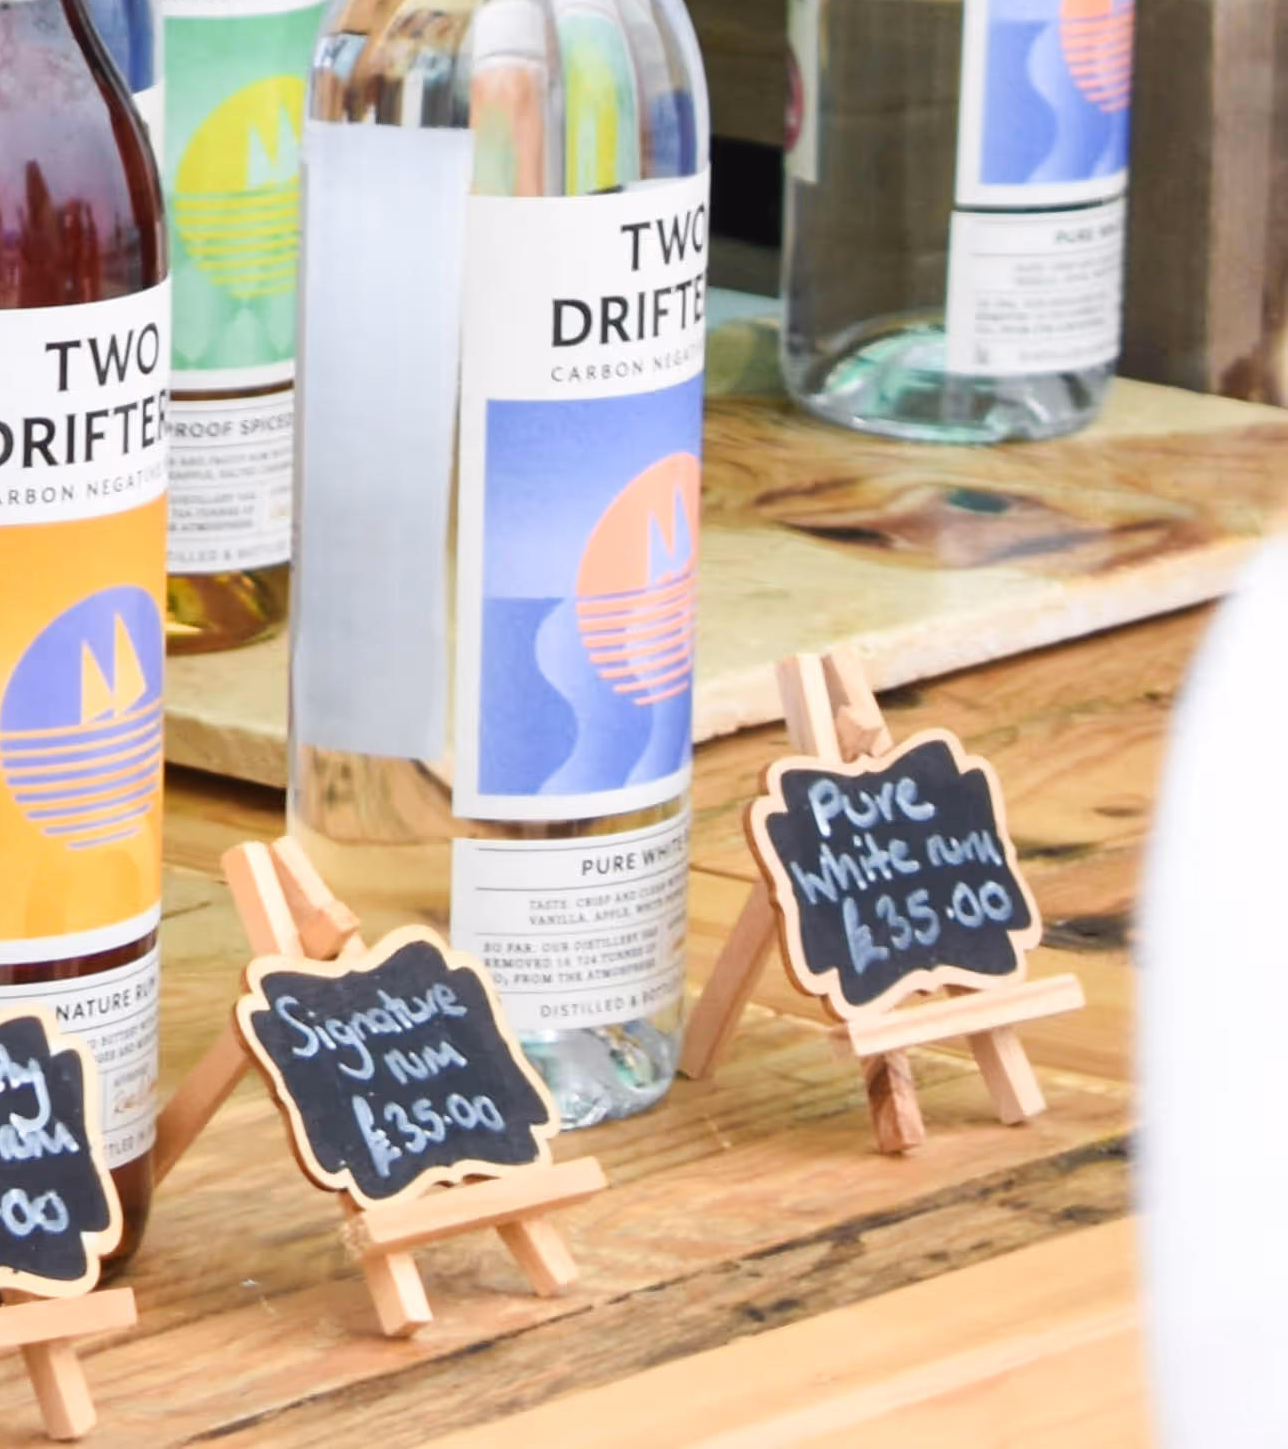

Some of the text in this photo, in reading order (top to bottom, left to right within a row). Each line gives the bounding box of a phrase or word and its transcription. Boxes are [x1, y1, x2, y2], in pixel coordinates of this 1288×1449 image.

[45, 322, 160, 392] TWO
[551, 360, 644, 383] CARBON
[808, 777, 936, 838] Pure
[581, 852, 636, 876] PURE
[926, 830, 1004, 869] rum
[542, 942, 569, 953] OUR
[514, 972, 553, 984] FROM
[558, 971, 582, 983] THE
[55, 988, 130, 1022] NATURE
[540, 996, 625, 1018] DISTILLED
[274, 982, 469, 1080] Signature
[384, 1039, 468, 1085] rum
